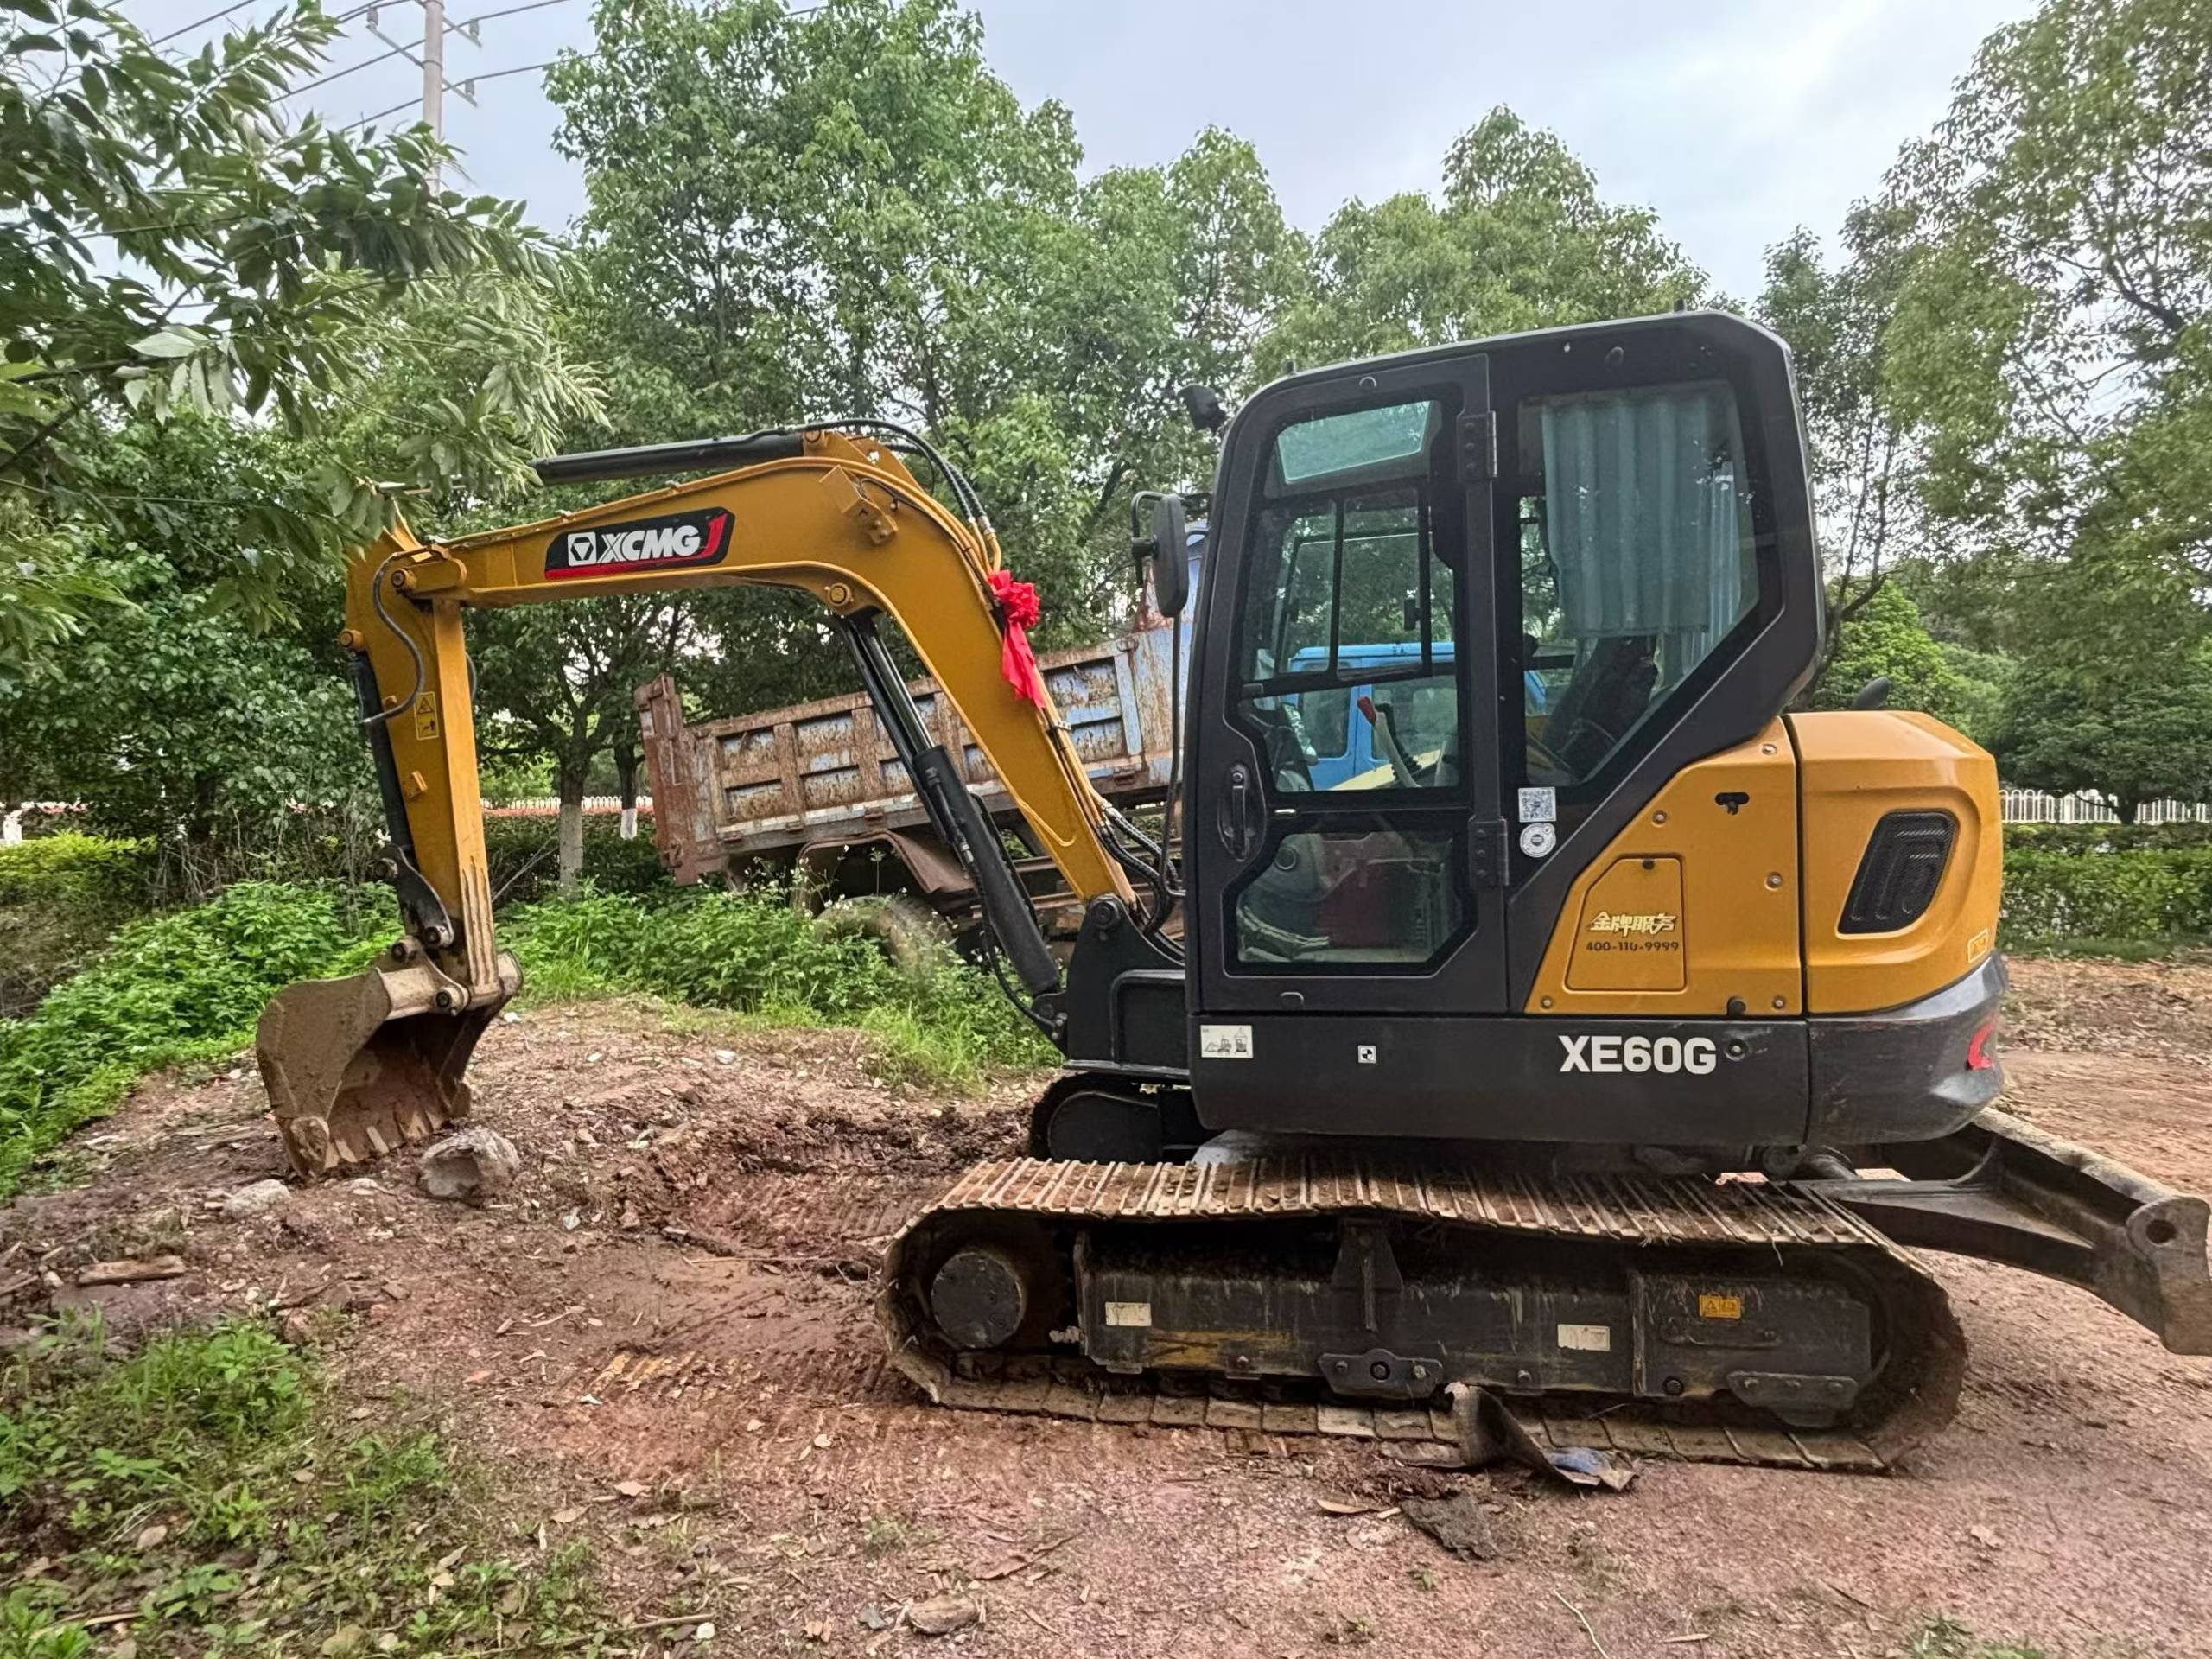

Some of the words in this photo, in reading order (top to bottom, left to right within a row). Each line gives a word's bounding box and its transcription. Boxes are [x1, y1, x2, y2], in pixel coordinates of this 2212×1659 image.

[597, 525, 701, 563] XCMG
[1589, 911, 1677, 938] 金牌服务
[1558, 1035, 1717, 1075] XE60G
